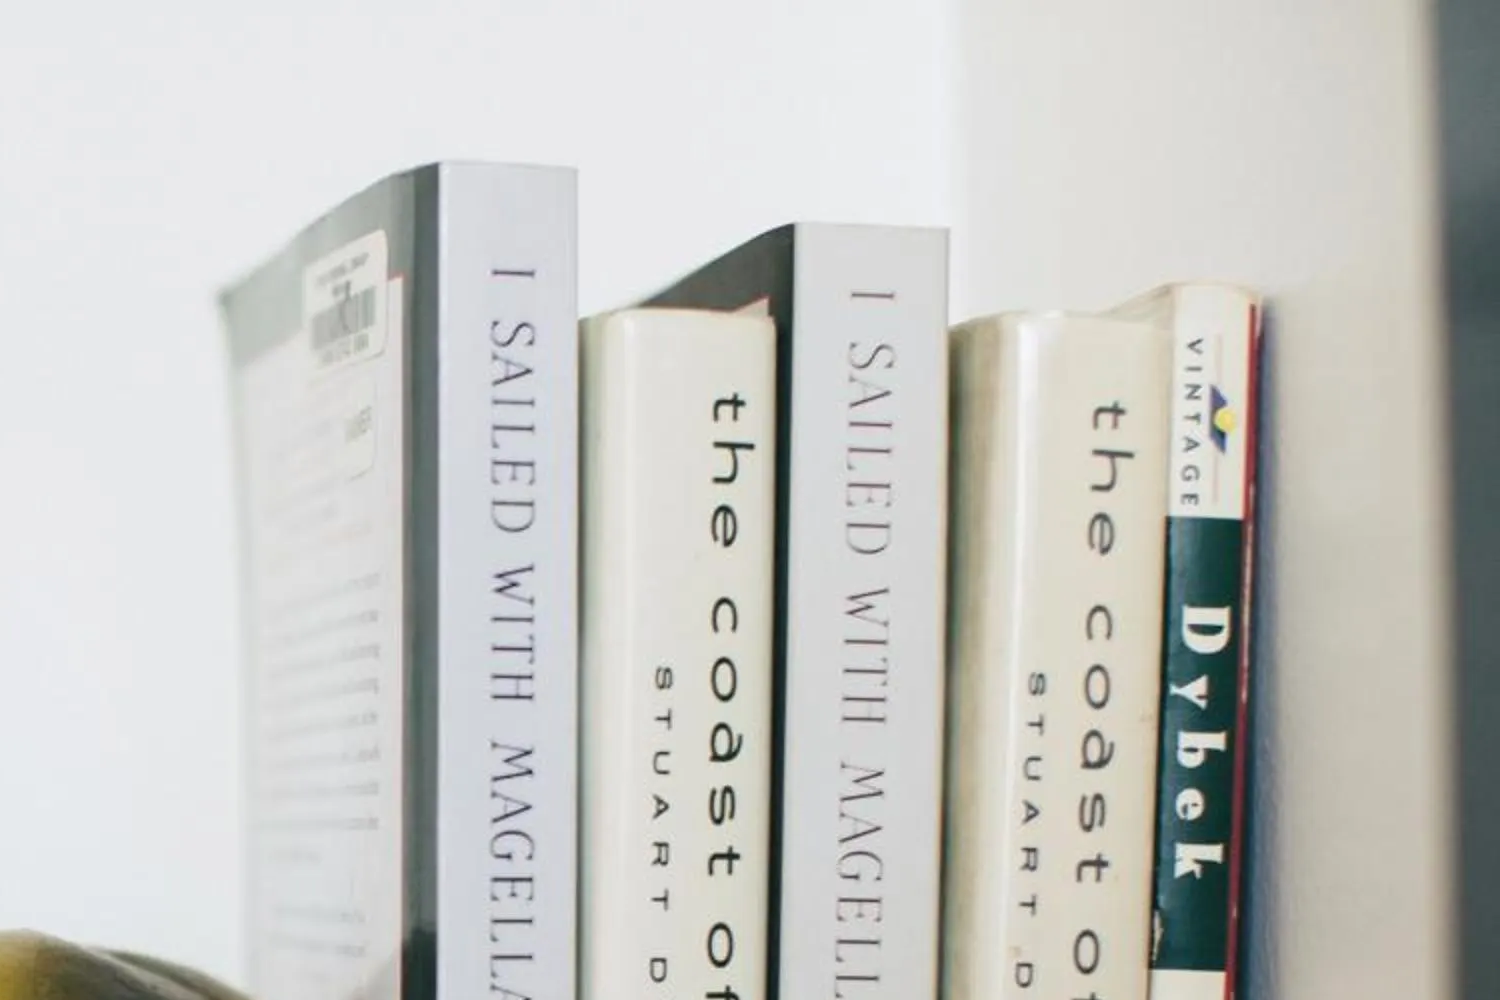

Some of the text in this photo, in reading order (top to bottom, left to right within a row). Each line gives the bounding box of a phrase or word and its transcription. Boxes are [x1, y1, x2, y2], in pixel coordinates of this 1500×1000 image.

[491, 267, 535, 278] I
[851, 290, 895, 299] I
[490, 319, 535, 533] SAILED
[711, 393, 755, 548] the
[846, 341, 896, 555] SAILED
[1087, 400, 1135, 556] the
[1180, 338, 1204, 506] VINTAGE
[490, 564, 535, 702] WITH
[842, 587, 890, 725] WITH
[651, 666, 674, 910] STUART
[708, 597, 743, 876] coast
[1018, 672, 1046, 916] STUART
[1076, 605, 1115, 883] coast
[1169, 605, 1232, 880] Dybek
